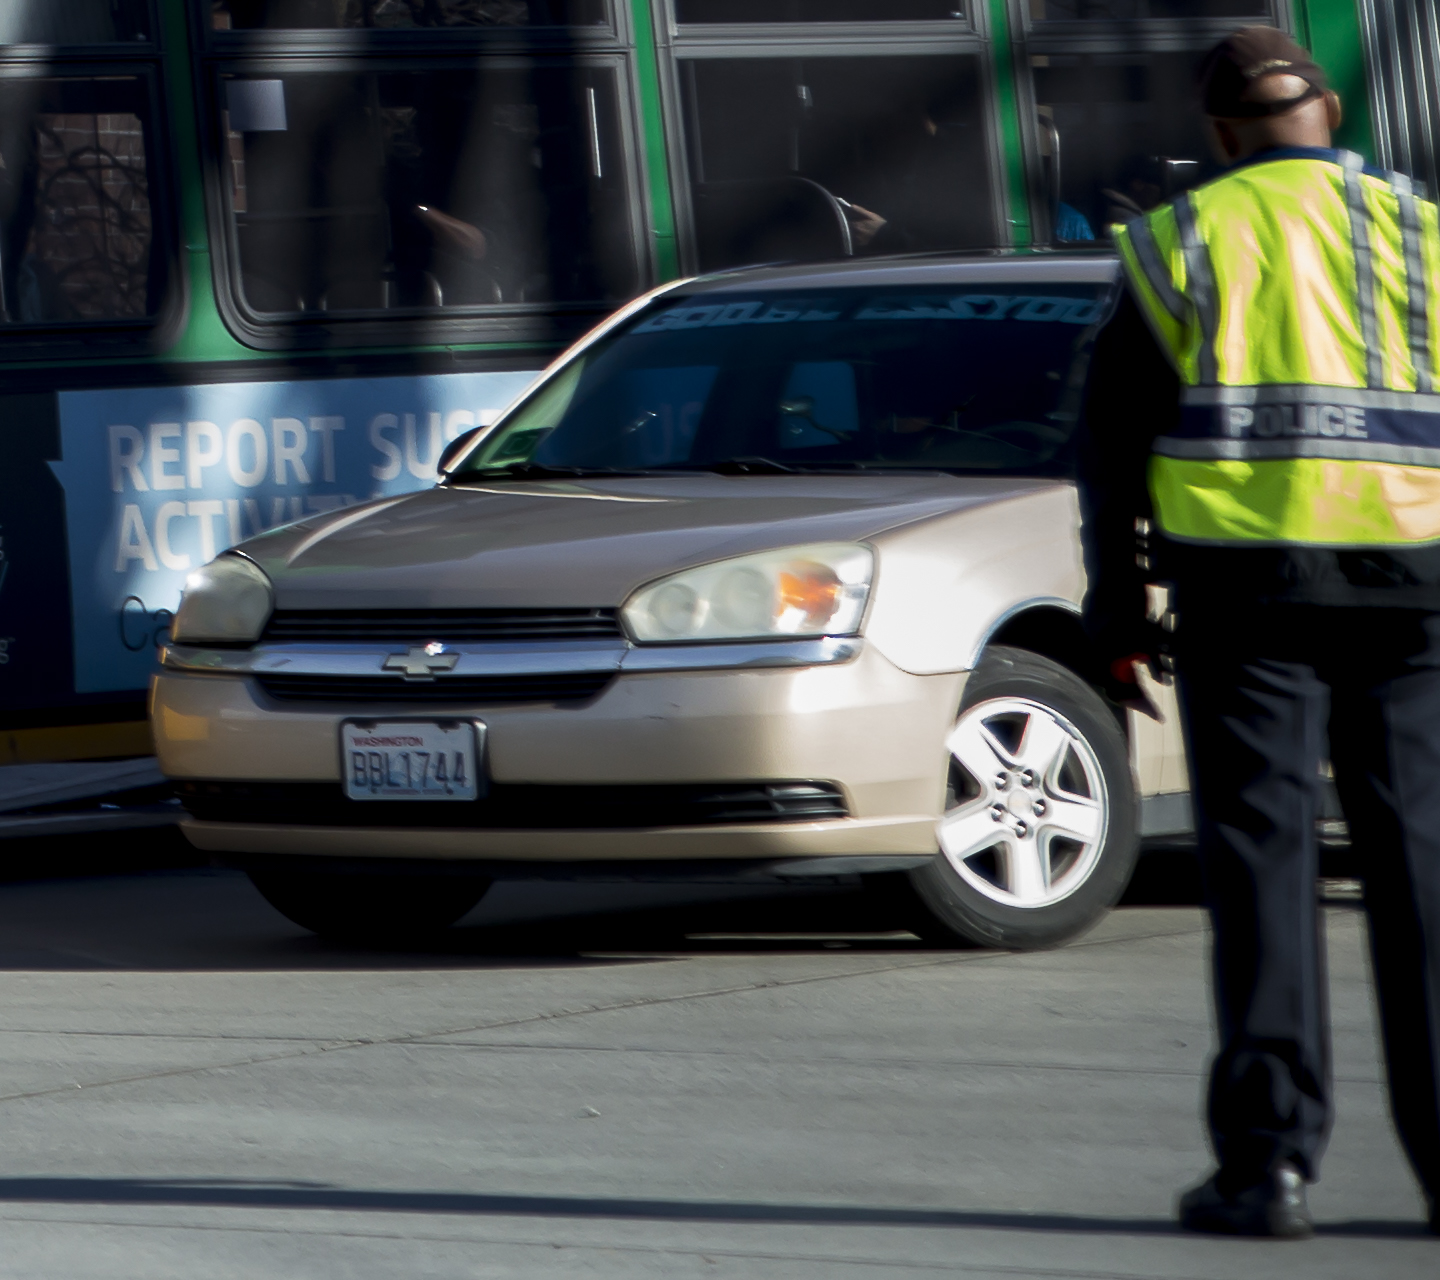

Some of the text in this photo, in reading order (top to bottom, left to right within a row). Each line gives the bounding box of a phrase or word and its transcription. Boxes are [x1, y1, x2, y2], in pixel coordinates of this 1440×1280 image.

[1228, 404, 1369, 439] POLICE
[107, 414, 347, 493] REPORT
[351, 750, 467, 789] BBL1744
